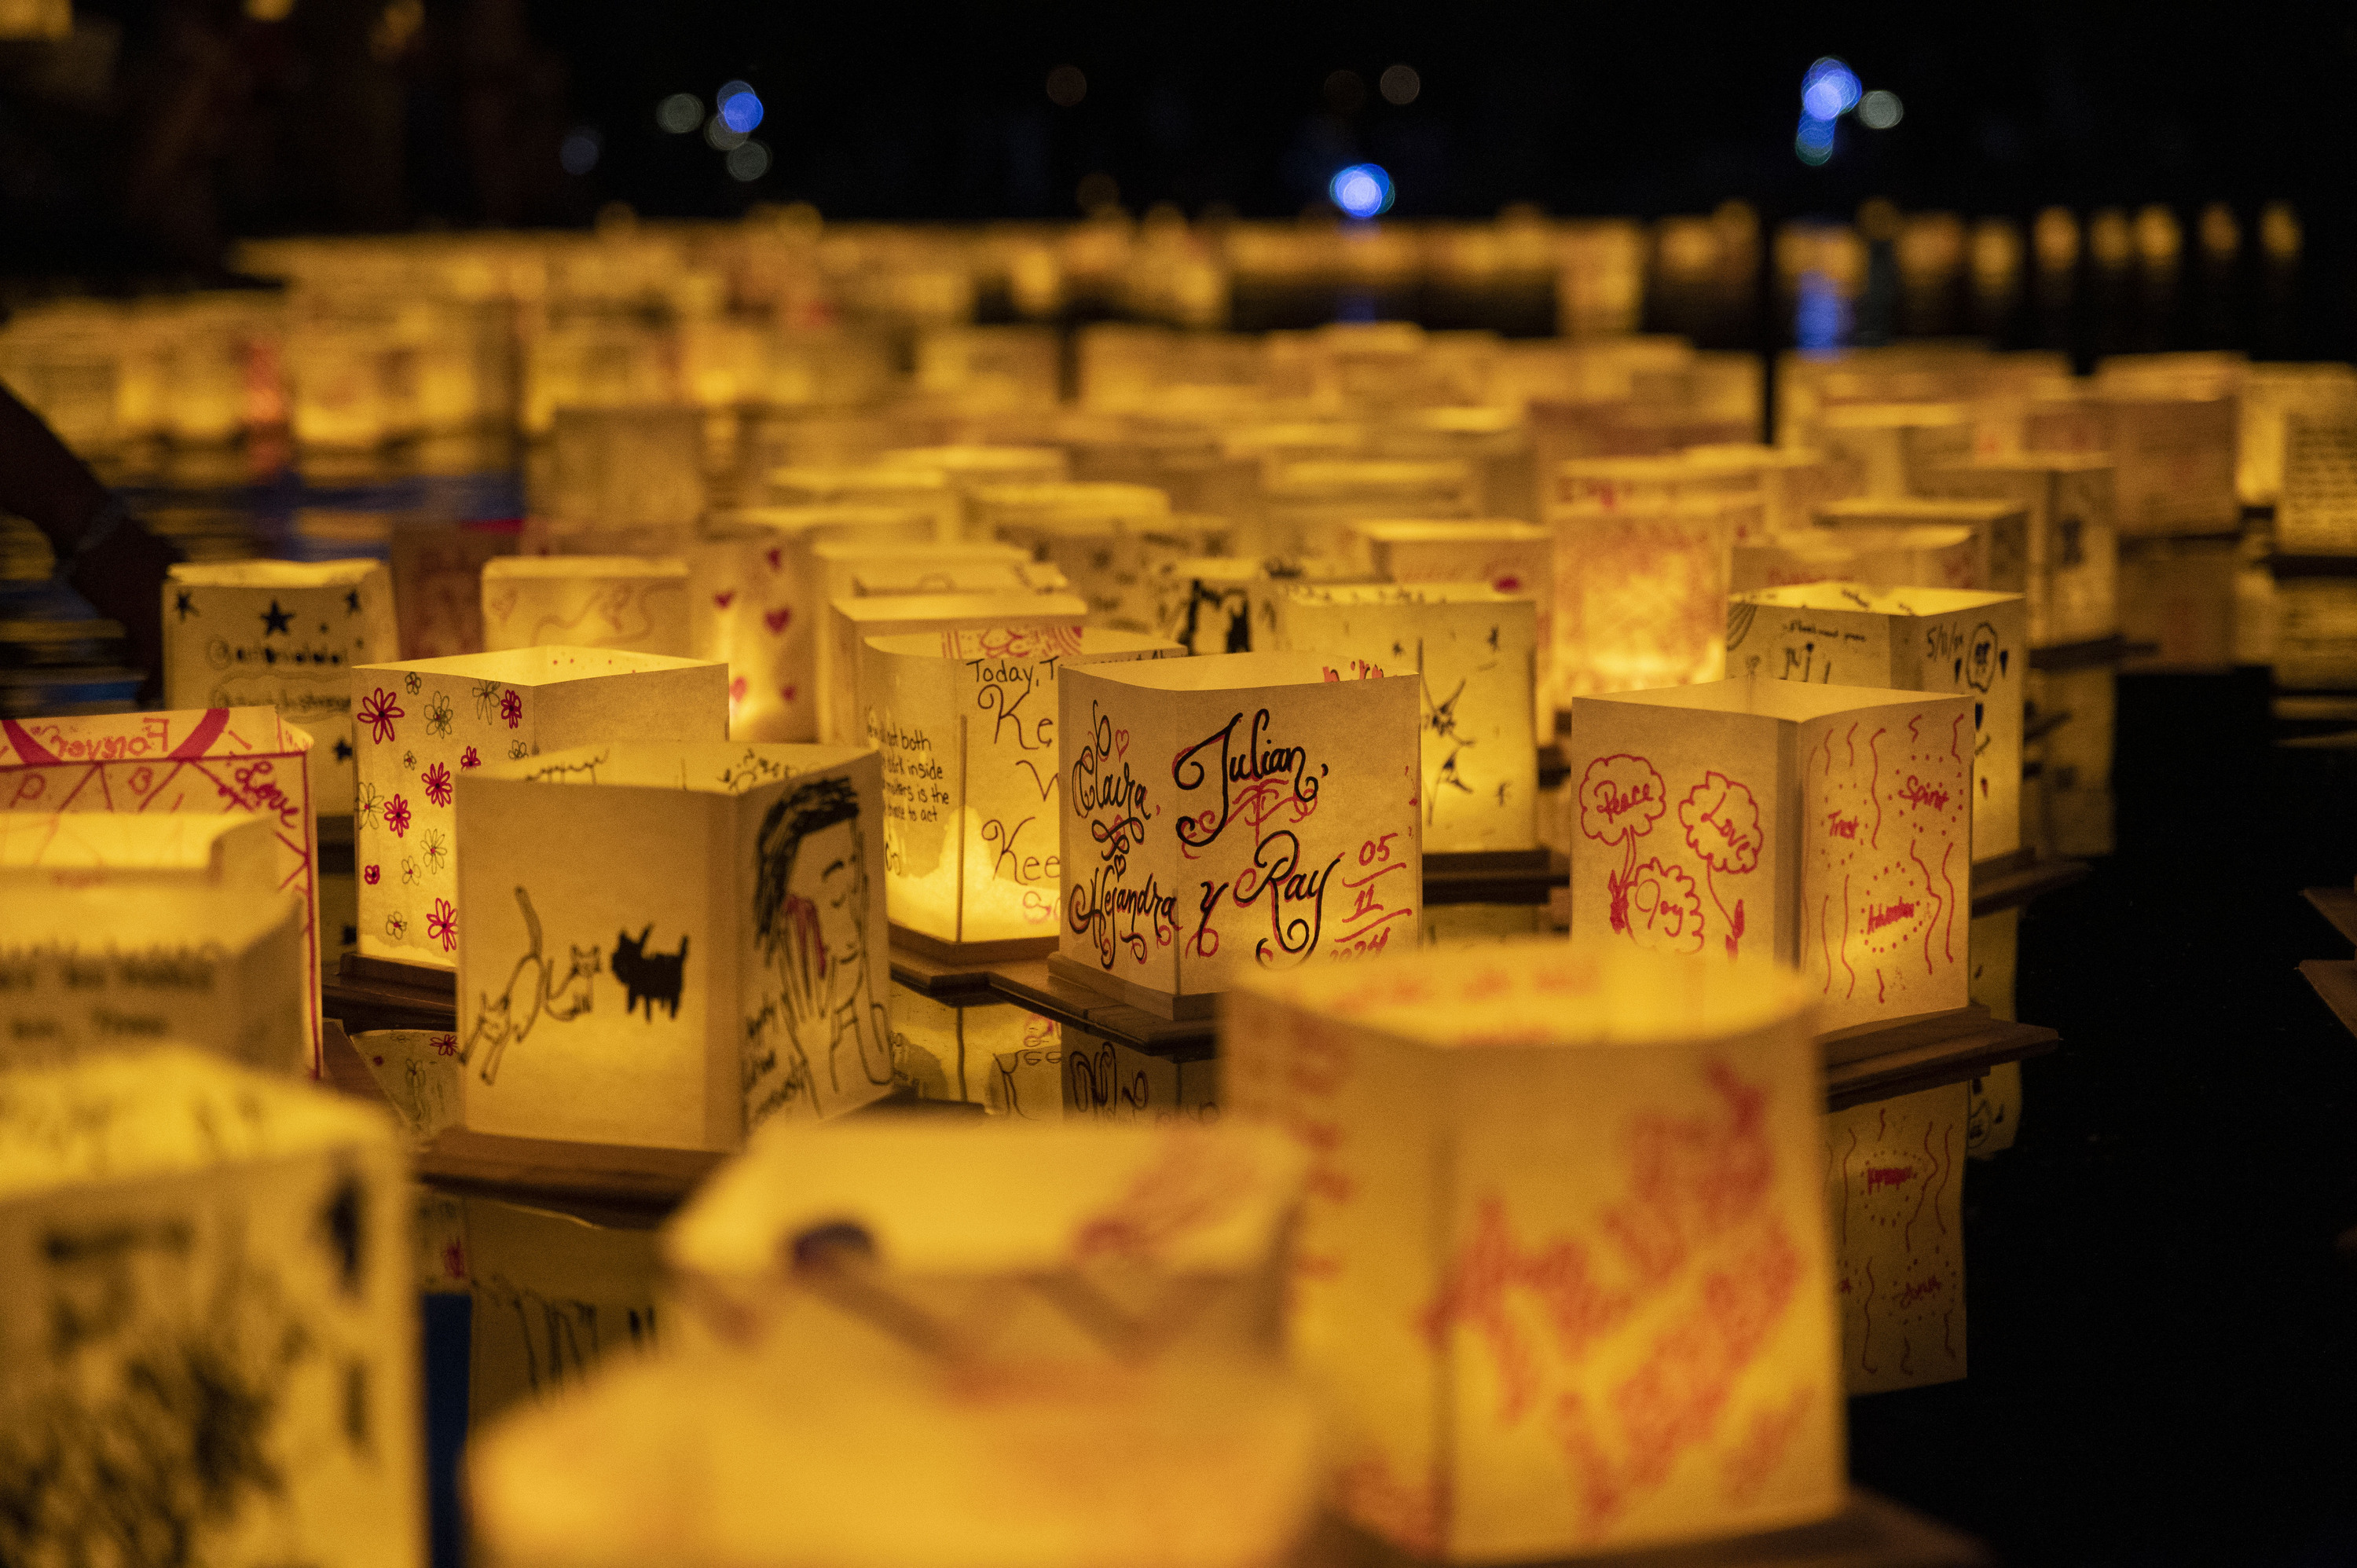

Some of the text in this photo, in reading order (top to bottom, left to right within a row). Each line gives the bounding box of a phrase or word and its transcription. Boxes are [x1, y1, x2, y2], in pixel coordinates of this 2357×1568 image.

[965, 658, 1039, 693] Today,
[900, 729, 932, 751] both
[907, 758, 944, 780] inside
[1172, 709, 1329, 848] Julian,
[918, 789, 928, 803] is
[930, 783, 949, 805] the
[1593, 779, 1655, 825] Peace
[907, 806, 918, 822] to
[920, 806, 938, 822] act
[1700, 791, 1751, 862] Love
[1358, 832, 1398, 866] 05
[1233, 830, 1346, 971] Ray
[1341, 883, 1385, 924] 11
[1635, 878, 1684, 939] Joy
